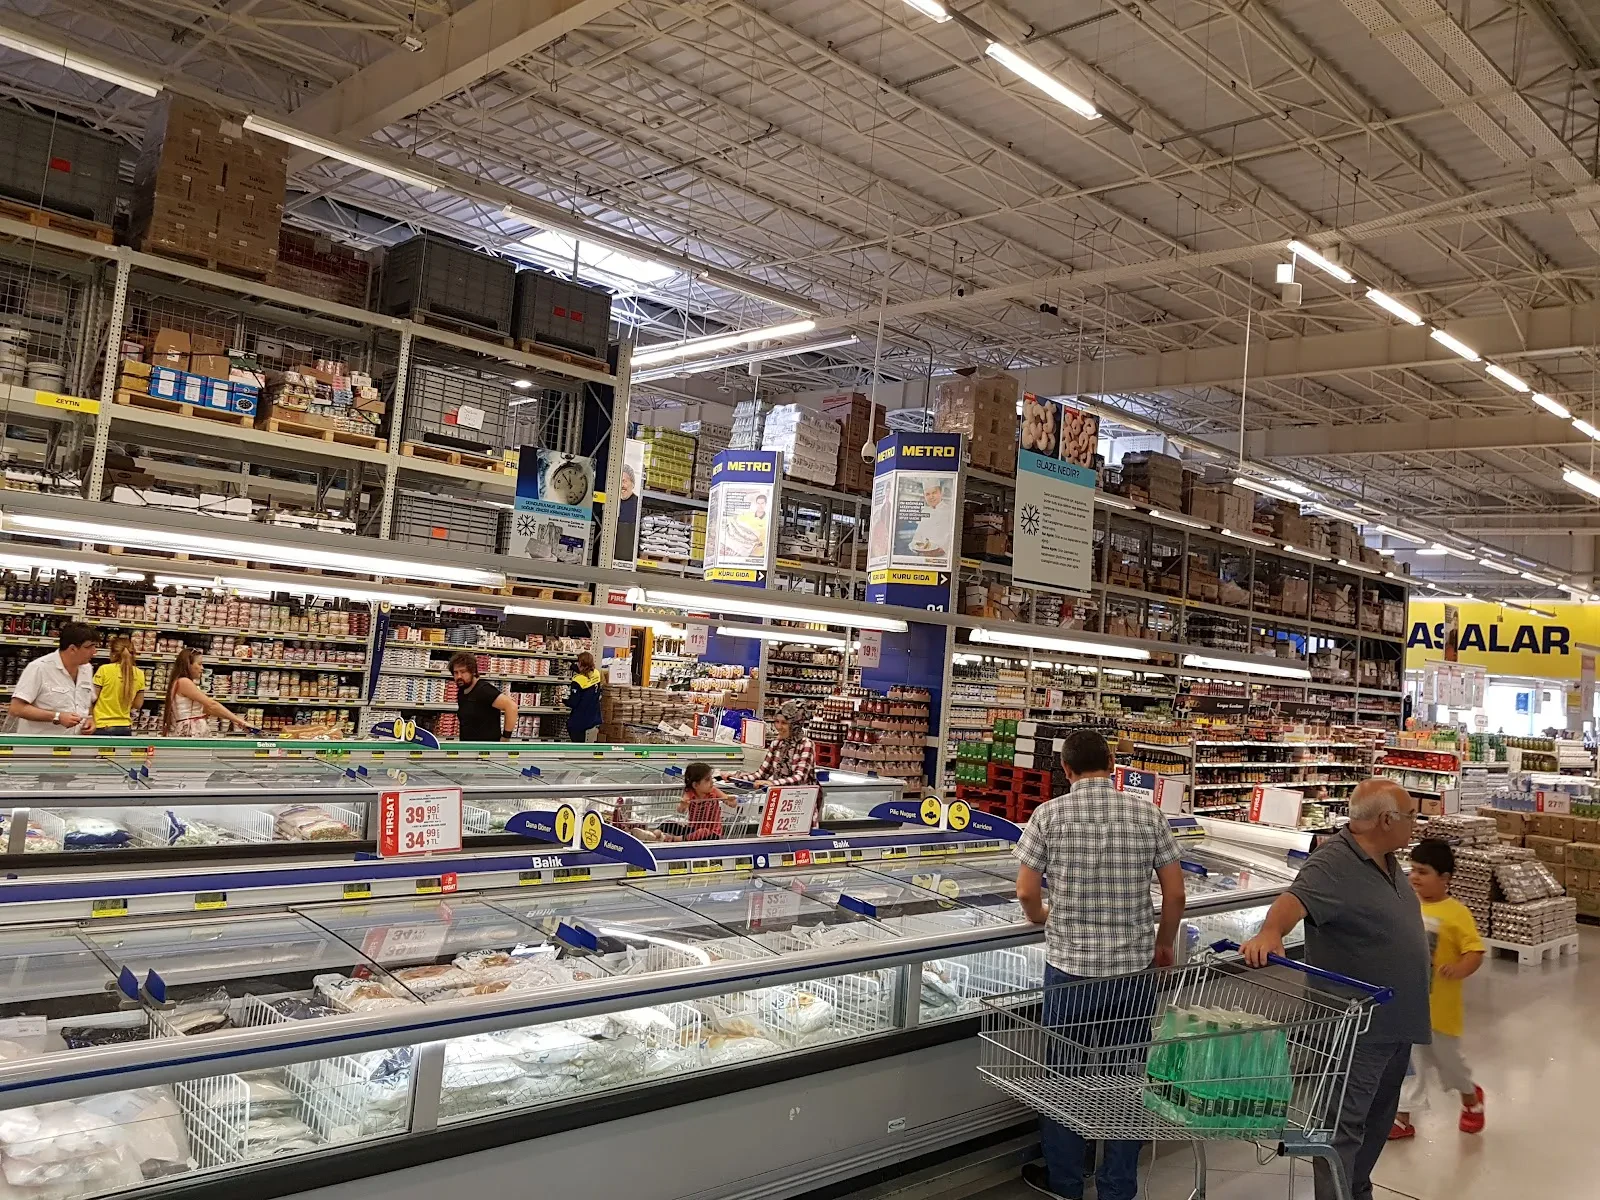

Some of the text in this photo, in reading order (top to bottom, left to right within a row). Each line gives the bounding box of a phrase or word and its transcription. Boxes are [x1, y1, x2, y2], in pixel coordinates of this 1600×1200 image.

[877, 446, 896, 463] METRO
[902, 445, 955, 458] METRO
[727, 461, 772, 472] METRO
[1036, 459, 1056, 473] GLAZE
[735, 569, 750, 578] GIDA
[862, 645, 871, 656] 19
[767, 791, 778, 821] FIRSAT
[780, 799, 794, 812] 25
[386, 797, 395, 836] FIRSAT
[405, 806, 424, 824] 39
[899, 810, 917, 819] Nugget
[525, 820, 552, 833] Dana Döner
[776, 818, 789, 831] 22
[972, 821, 993, 831] Karides
[405, 831, 425, 849] 34
[603, 839, 624, 853] Kalamar
[532, 855, 563, 868] Balık
